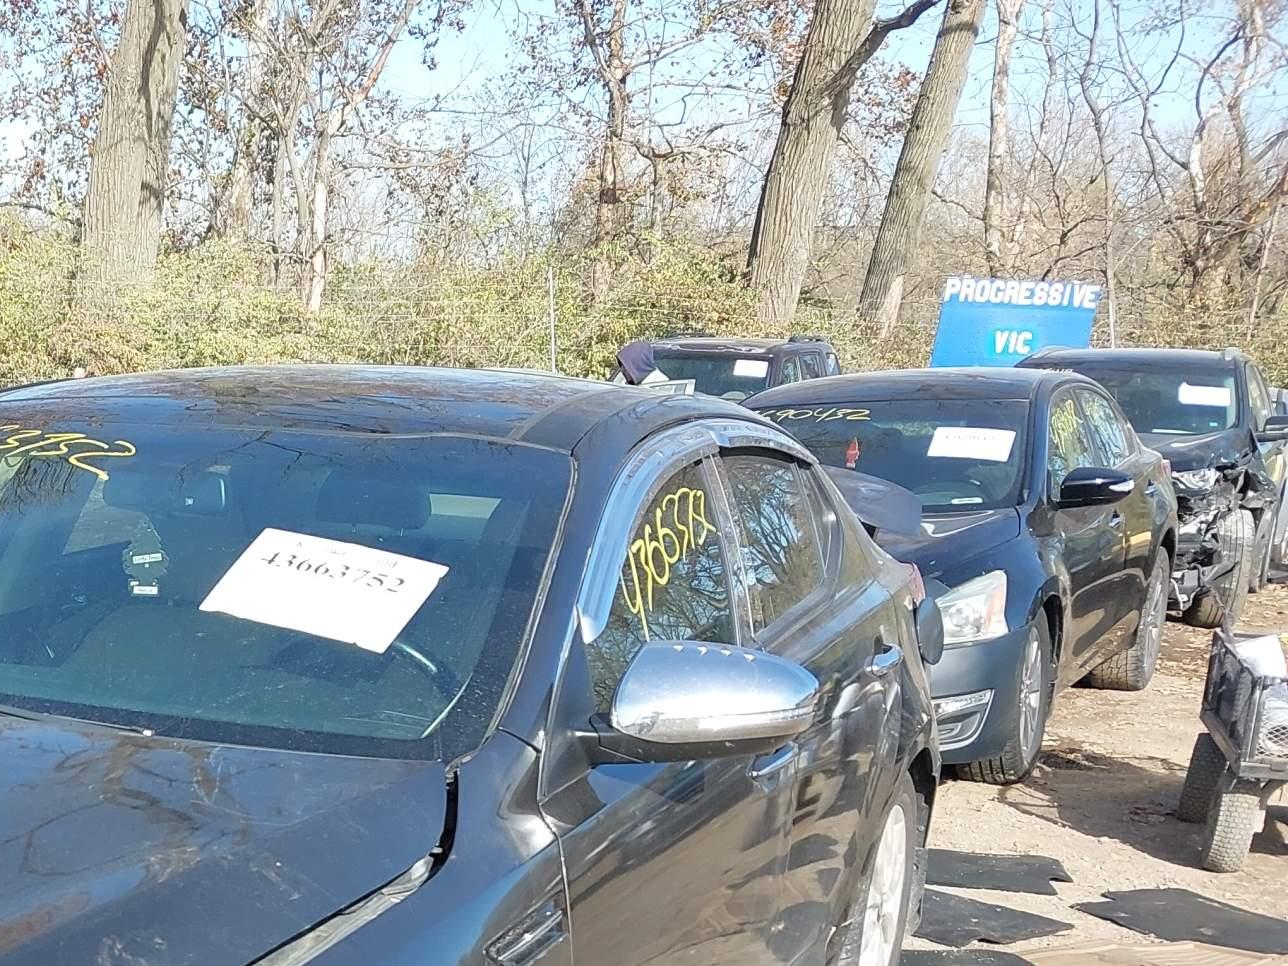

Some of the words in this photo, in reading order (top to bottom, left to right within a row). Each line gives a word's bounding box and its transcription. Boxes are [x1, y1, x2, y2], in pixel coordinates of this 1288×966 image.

[943, 276, 1101, 309] PROGRESSIVE
[994, 330, 1033, 355] VIC
[260, 551, 405, 593] 43663752
